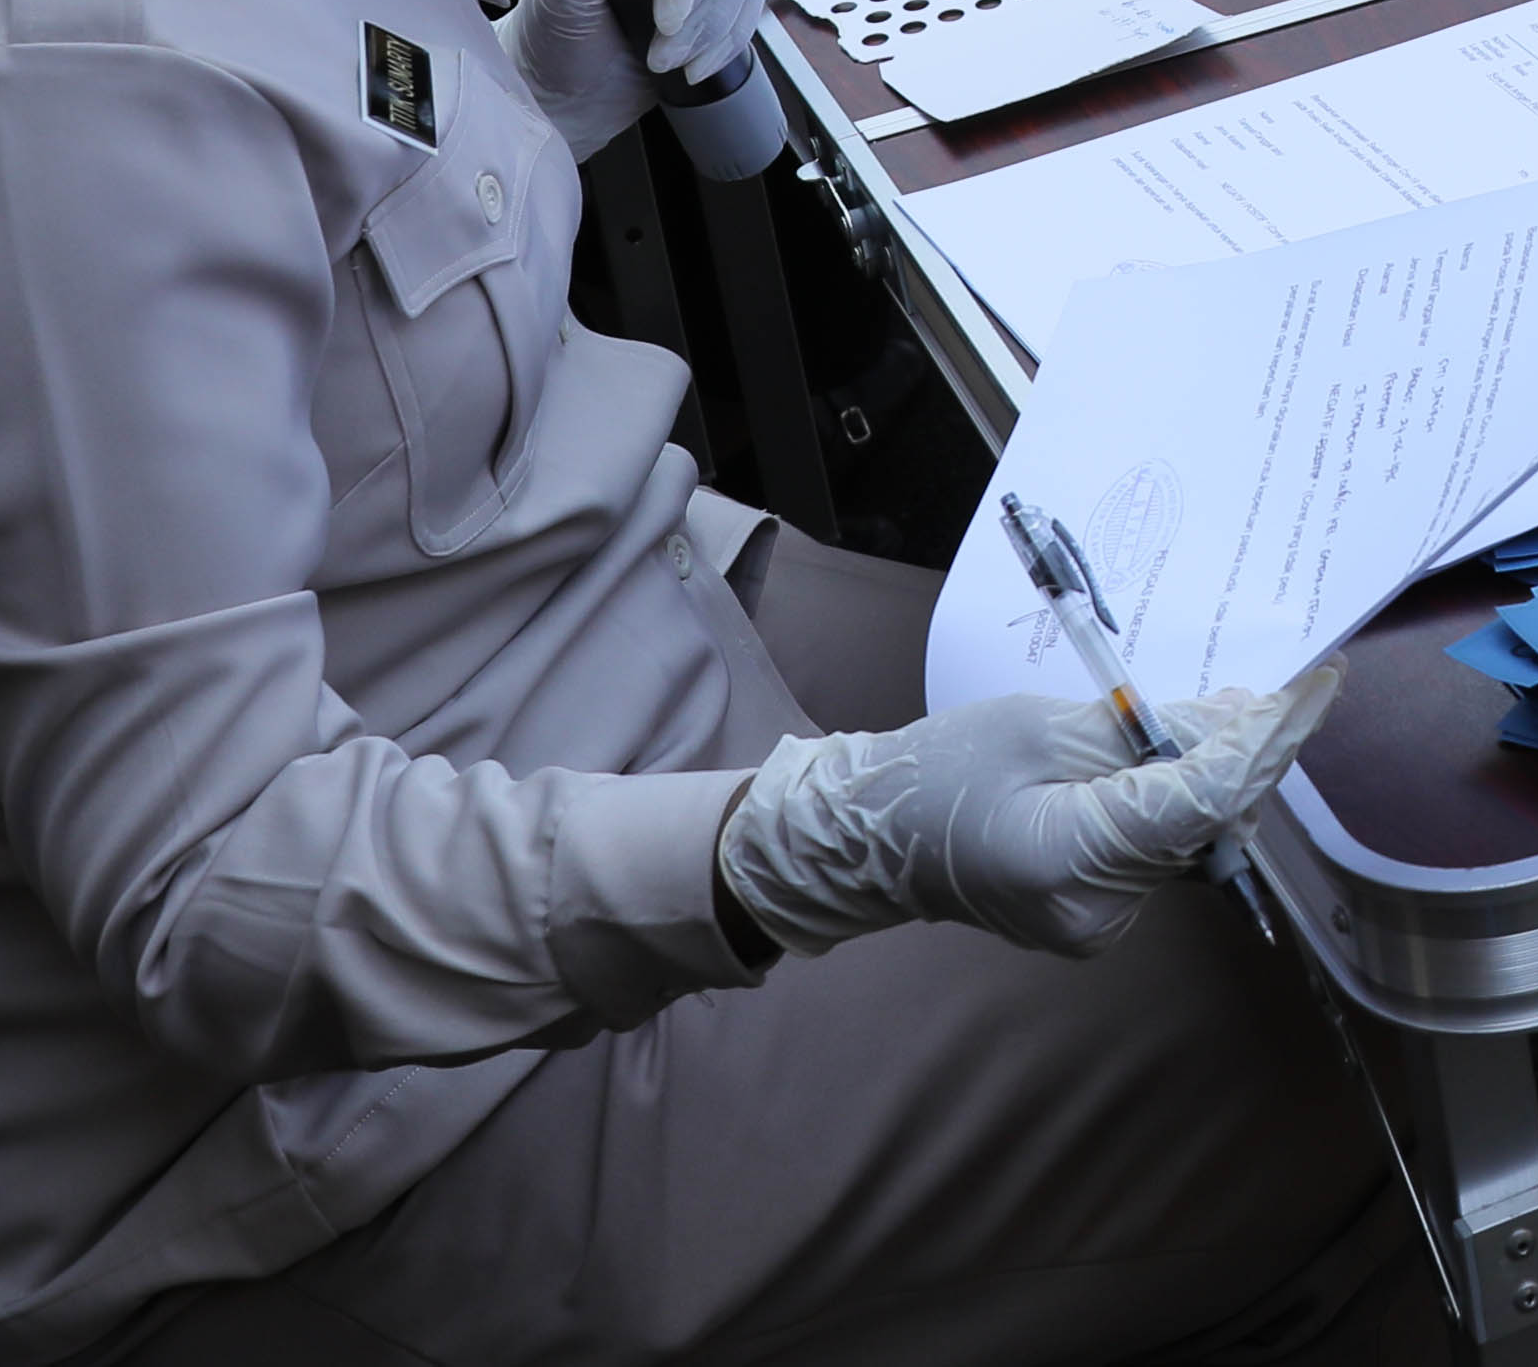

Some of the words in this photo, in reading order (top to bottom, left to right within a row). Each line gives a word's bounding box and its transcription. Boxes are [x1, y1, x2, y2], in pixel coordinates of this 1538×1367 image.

[390, 92, 416, 129] TITIK
[1376, 260, 1396, 296] Alamat
[1456, 240, 1475, 272] Nama
[1344, 266, 1371, 323] Didapatkan
[1497, 285, 1526, 347] pemeriksaan
[1289, 304, 1316, 362] Keterangan
[1339, 322, 1357, 348] Hasil
[1476, 314, 1499, 353] Antigen
[1259, 352, 1283, 401] keperluan
[1481, 375, 1503, 412] Antigen
[1265, 404, 1290, 456] digunakan
[1318, 382, 1342, 430] NEGATIF
[1241, 483, 1268, 534] keperluan
[1140, 547, 1167, 598] PETUGAS
[1200, 622, 1224, 669] berlaku
